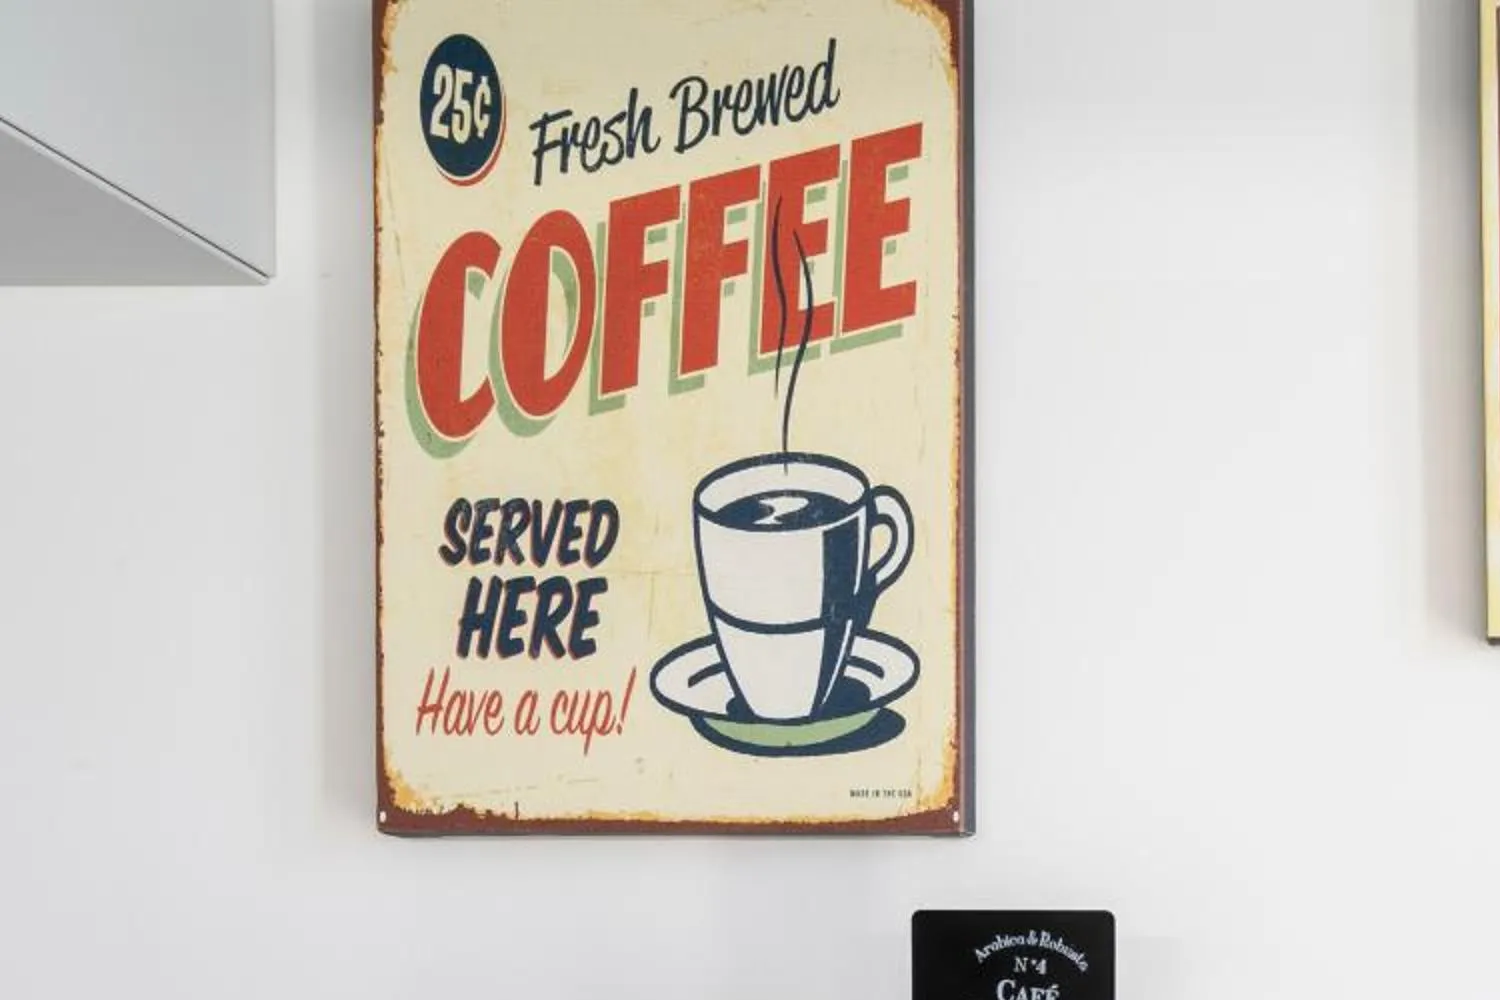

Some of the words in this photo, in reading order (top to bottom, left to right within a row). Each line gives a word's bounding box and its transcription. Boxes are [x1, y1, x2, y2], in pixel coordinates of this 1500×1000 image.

[429, 63, 492, 145] 25¢
[529, 88, 661, 186] Fresh
[669, 37, 841, 154] Brewed
[410, 121, 925, 446] COFFEE
[438, 497, 620, 568] SERVED
[456, 575, 609, 660] HERE
[415, 667, 505, 736] Have
[515, 696, 541, 736] a
[550, 666, 637, 757] cup!
